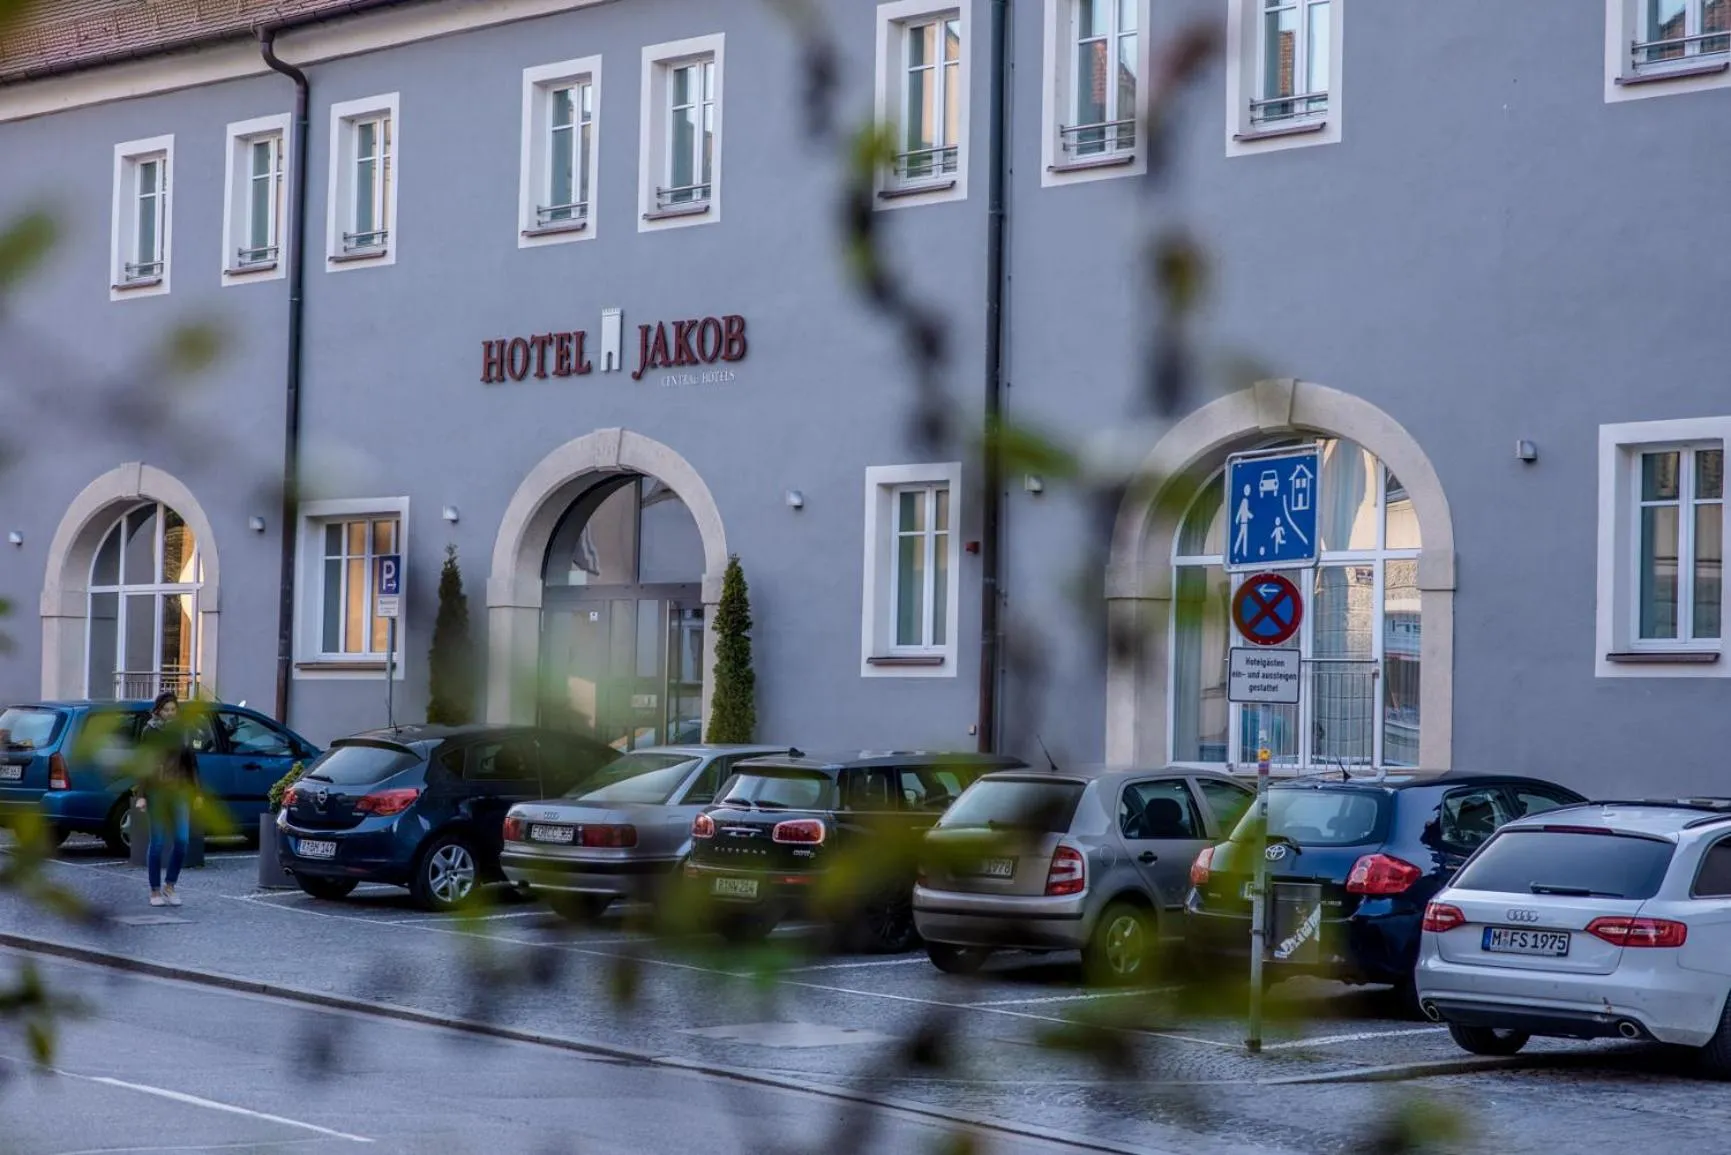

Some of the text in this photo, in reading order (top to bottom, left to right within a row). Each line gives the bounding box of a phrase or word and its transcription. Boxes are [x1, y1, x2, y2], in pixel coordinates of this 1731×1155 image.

[480, 315, 748, 384] HOTEL JAKOB
[382, 560, 396, 591] P
[1247, 670, 1260, 679] und
[1261, 672, 1297, 682] aussteigen
[1248, 684, 1279, 693] gestattet
[1492, 931, 1567, 951] M FS 1975
